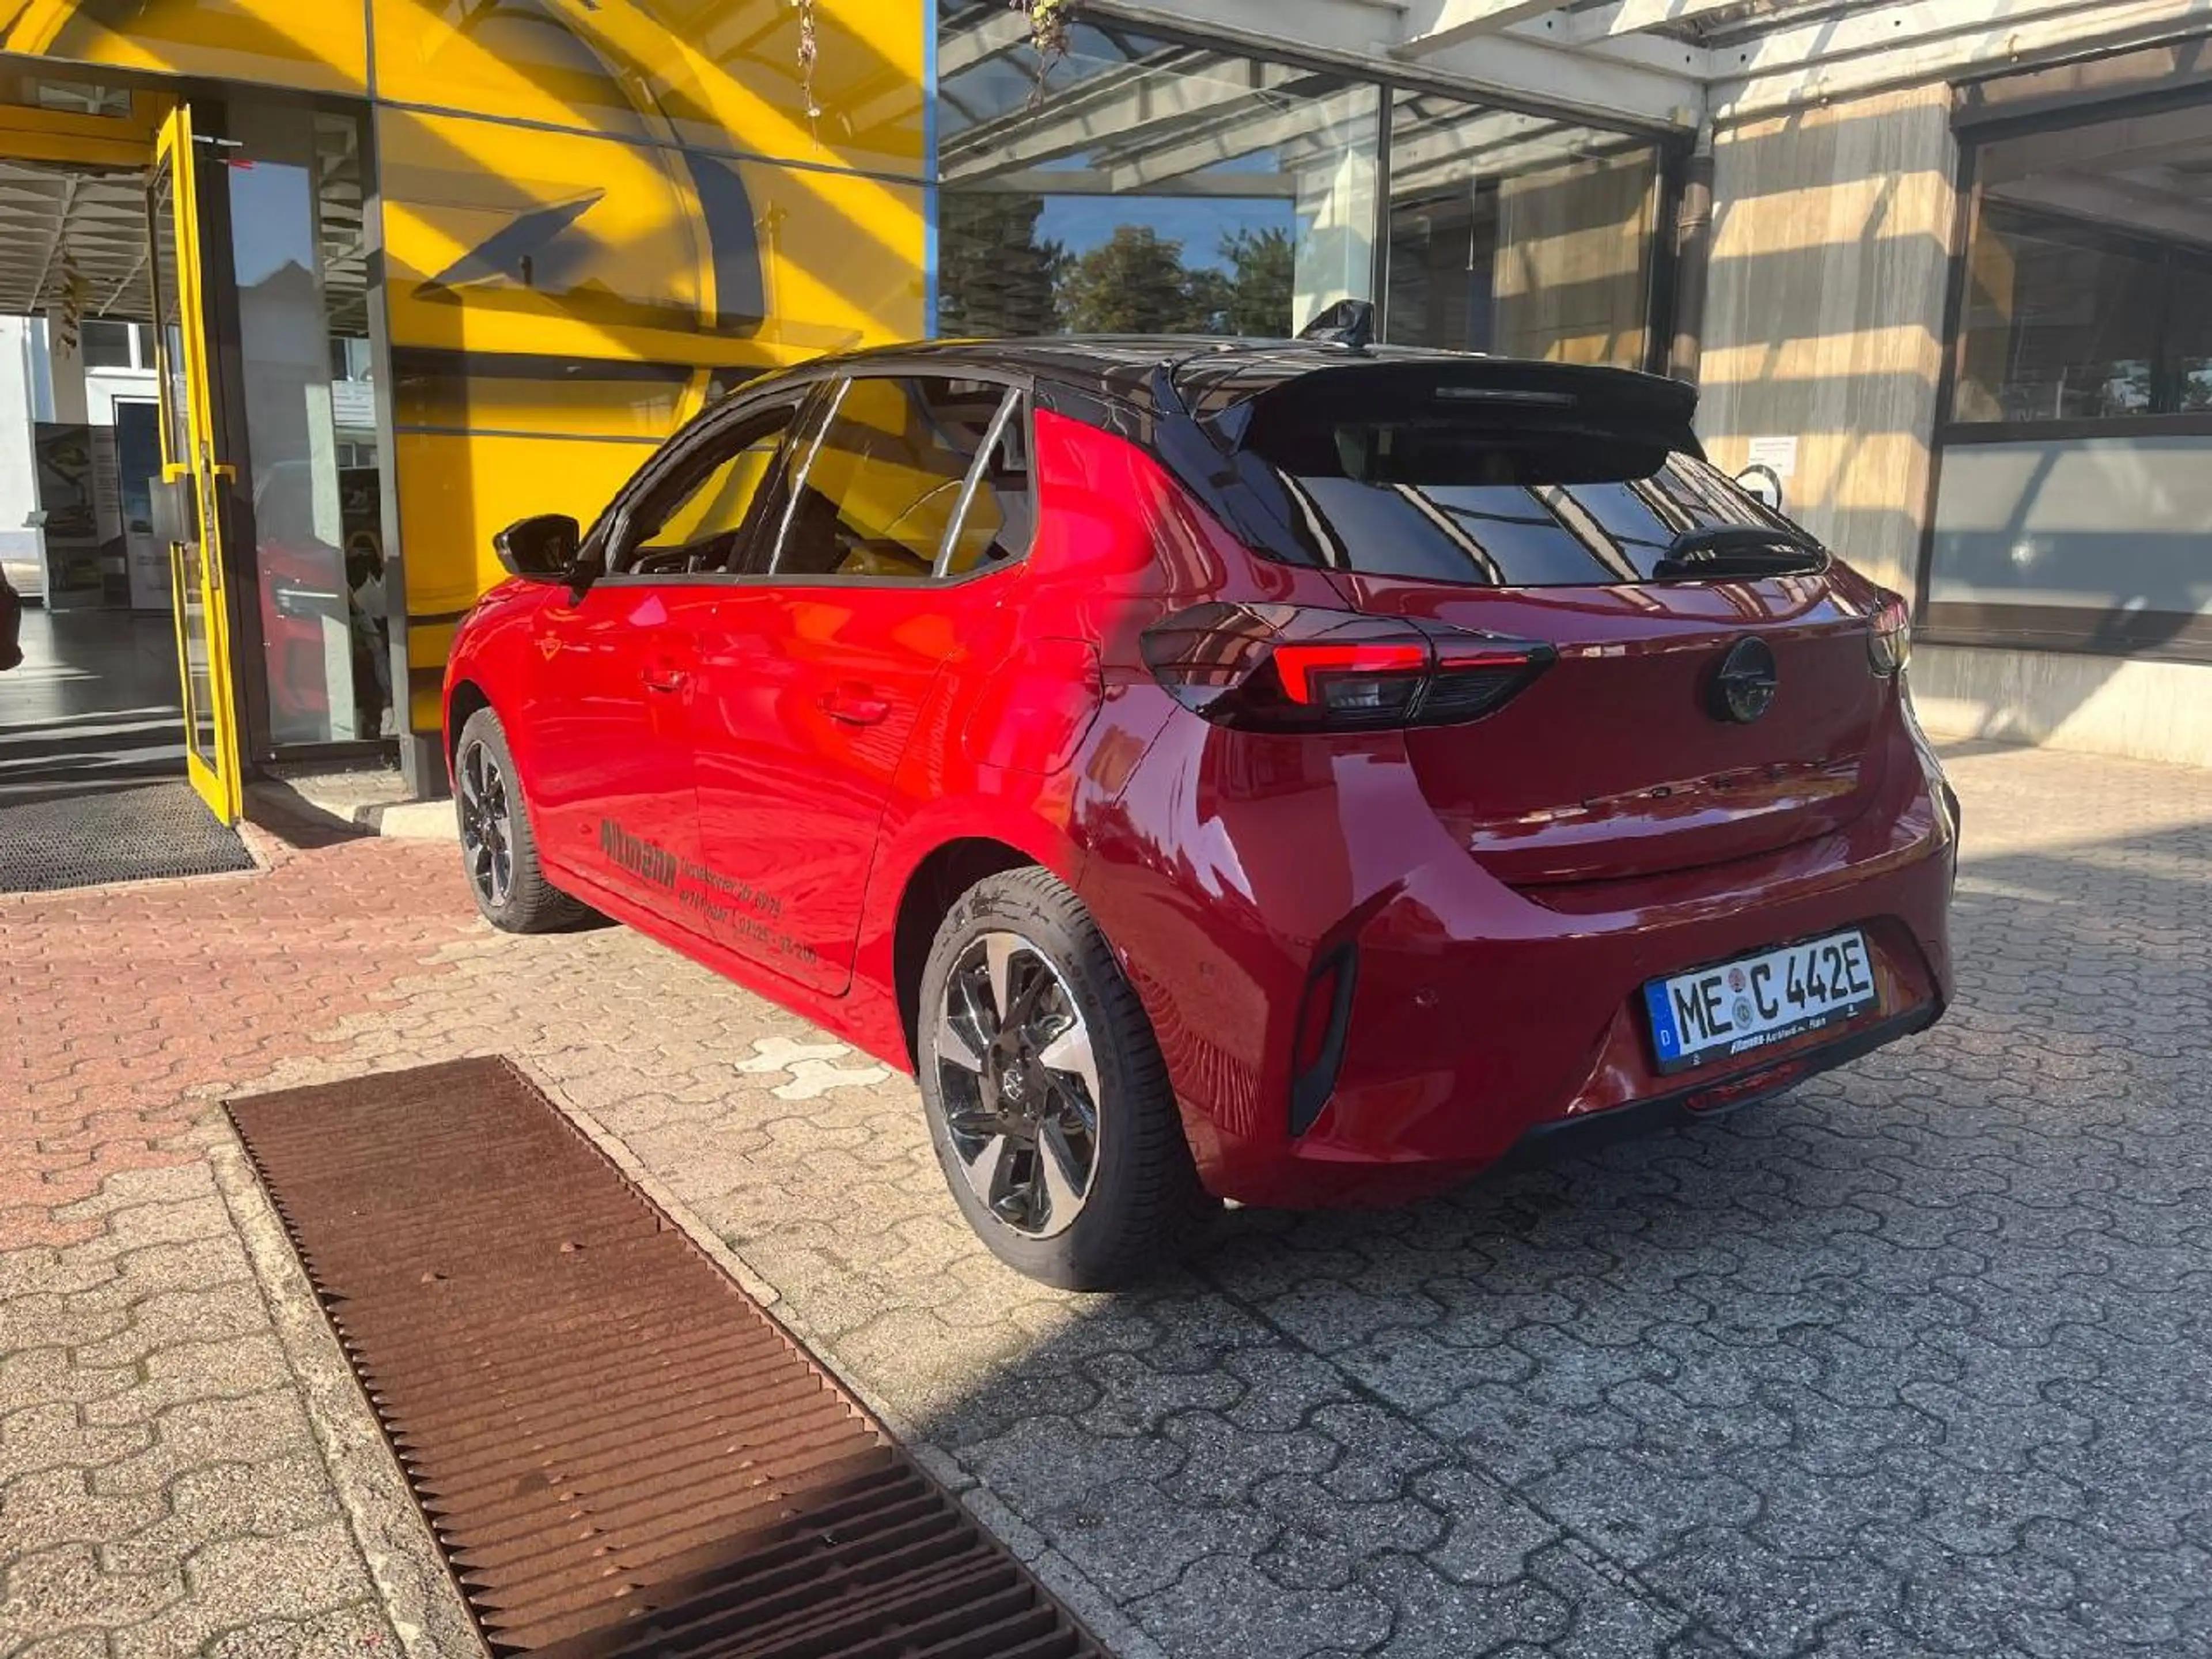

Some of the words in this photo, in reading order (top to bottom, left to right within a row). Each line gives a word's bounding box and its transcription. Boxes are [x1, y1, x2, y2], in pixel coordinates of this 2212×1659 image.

[1674, 976, 1732, 1044] ME
[1750, 963, 1779, 1020] C
[1786, 939, 1869, 1009] 442E
[1660, 1029, 1671, 1047] D
